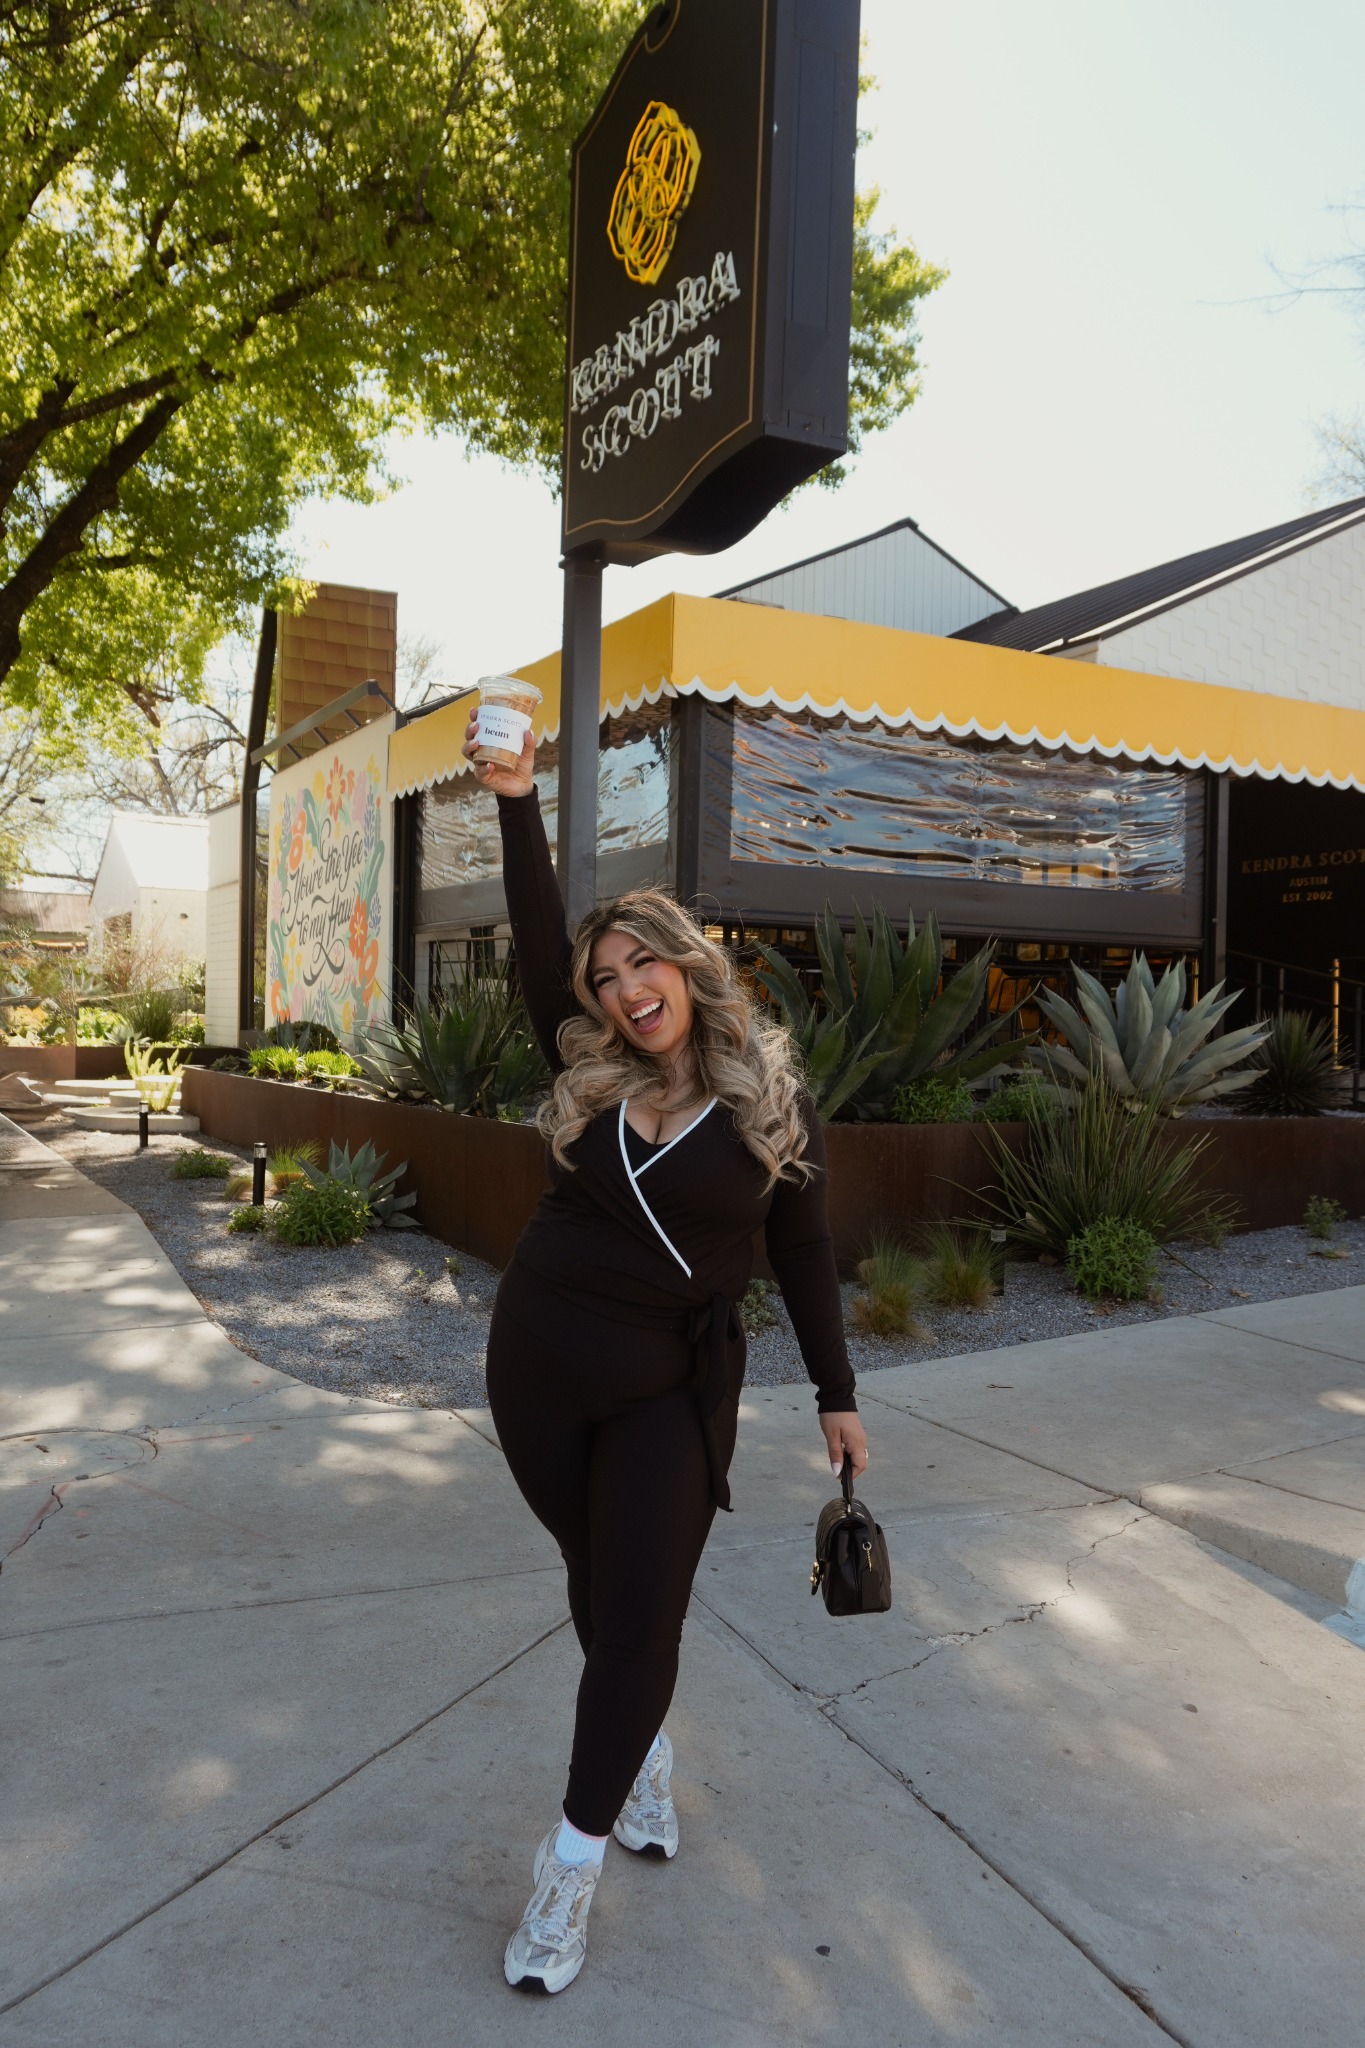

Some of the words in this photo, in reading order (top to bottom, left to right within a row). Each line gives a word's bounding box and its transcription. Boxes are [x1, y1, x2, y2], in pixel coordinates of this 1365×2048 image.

[571, 251, 741, 414] KENDRA
[580, 334, 720, 472] SCOTT
[484, 727, 509, 739] beam
[338, 830, 364, 893] Yee
[1241, 854, 1313, 874] KENDRA
[1289, 875, 1329, 888] AUSTIN
[1306, 889, 1334, 902] 2002
[296, 910, 310, 947] to
